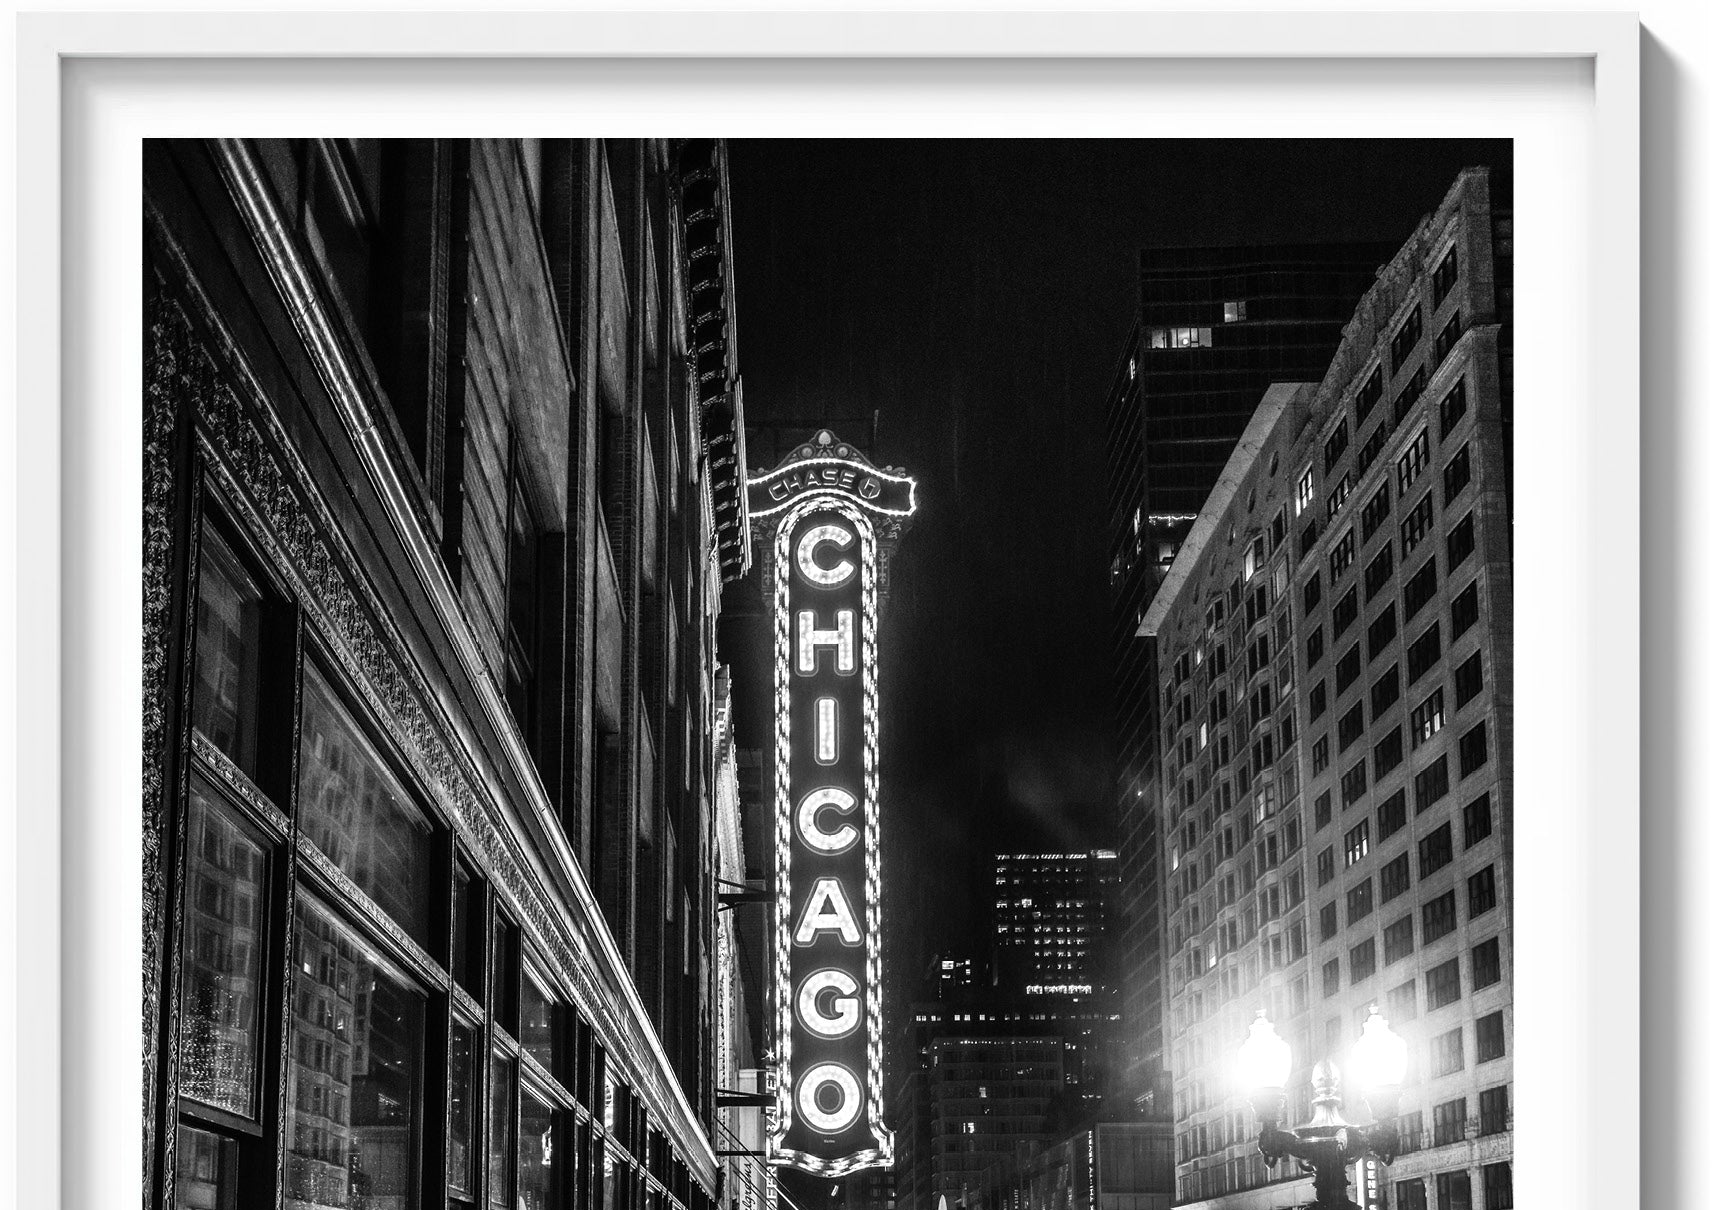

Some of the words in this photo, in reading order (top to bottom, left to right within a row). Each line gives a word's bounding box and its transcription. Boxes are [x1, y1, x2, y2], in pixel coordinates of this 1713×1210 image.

[768, 468, 856, 501] CHASE
[796, 524, 862, 1131] CHICAGO
[1366, 1160, 1378, 1199] GENE
